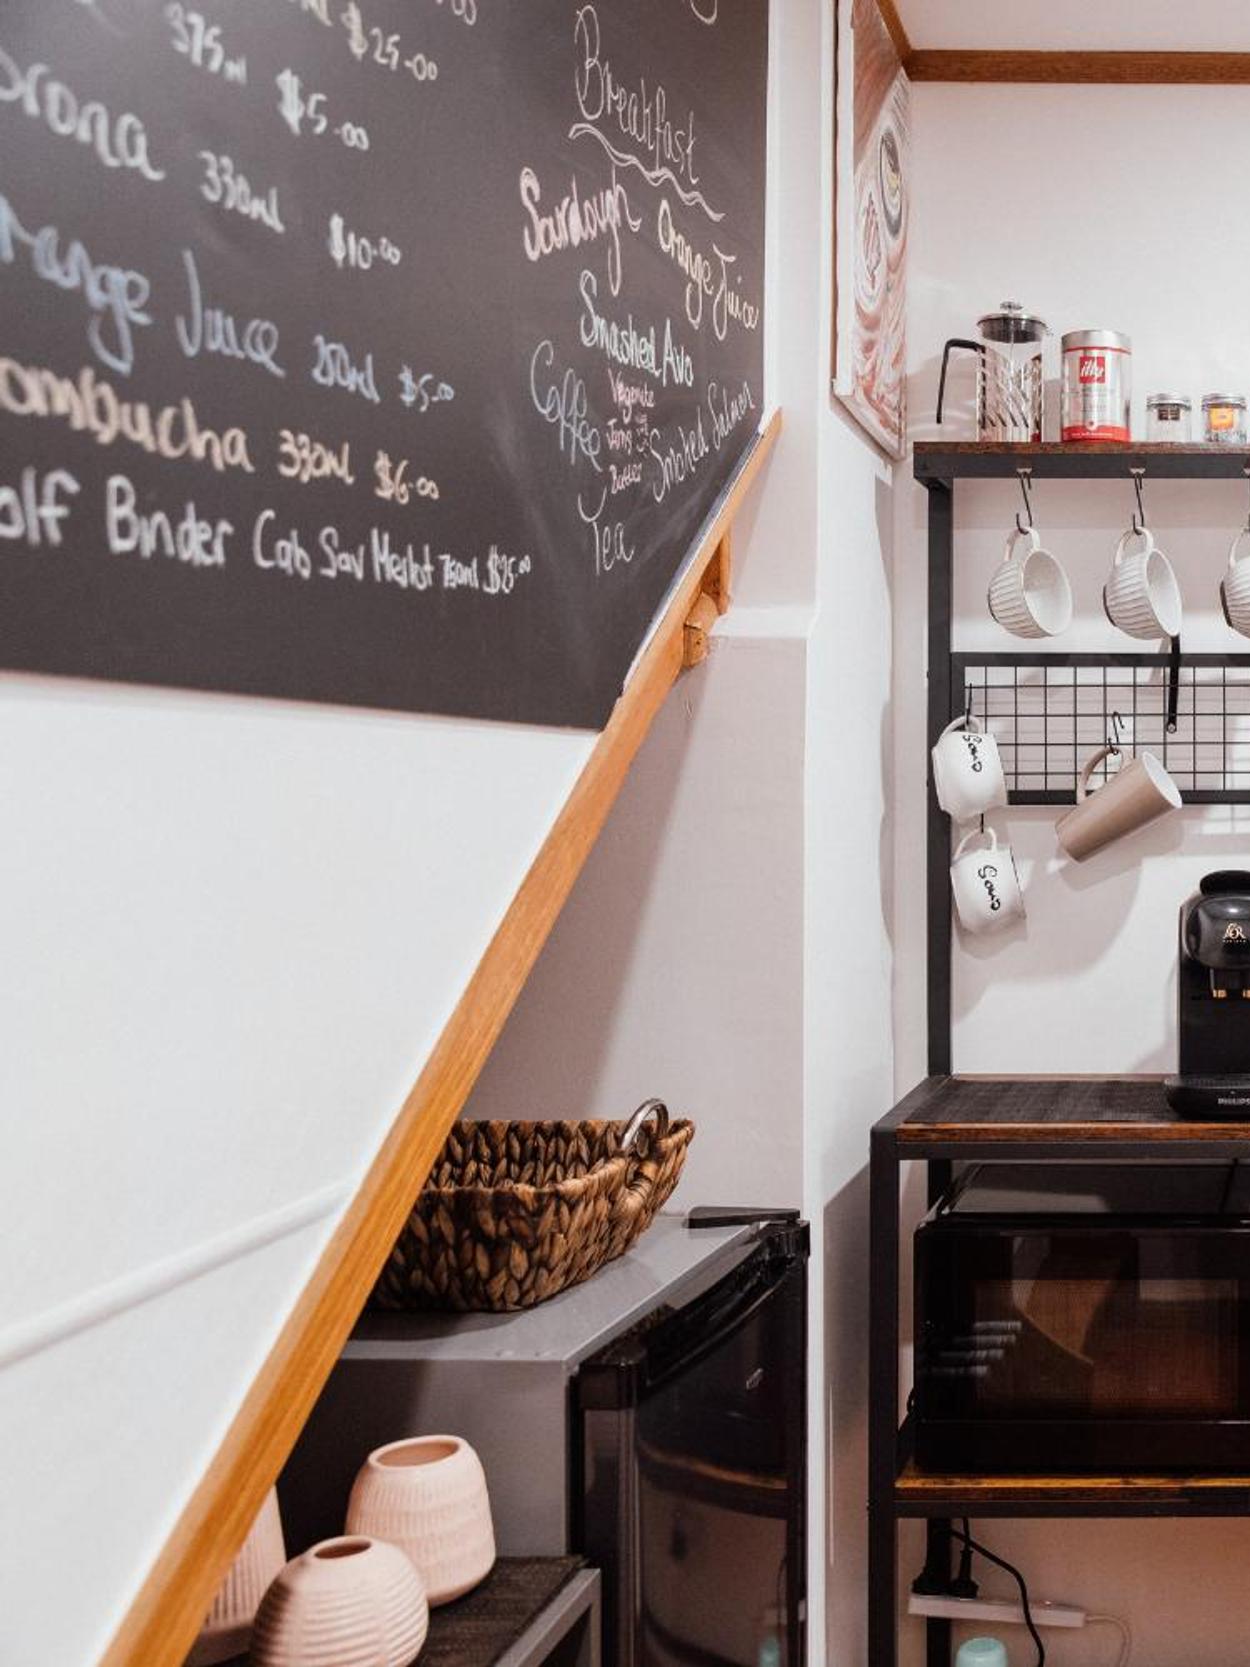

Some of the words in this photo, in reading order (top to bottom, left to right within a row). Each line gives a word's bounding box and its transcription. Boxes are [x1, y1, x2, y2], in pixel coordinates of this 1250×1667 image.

[574, 5, 700, 185] Breakfast
[519, 165, 643, 297] Sourdough
[658, 199, 714, 330] Orange
[712, 243, 759, 341] Juice
[579, 269, 662, 379] Smashed
[662, 317, 694, 388] Avo
[1080, 357, 1105, 379] illy
[530, 339, 603, 472] Coffee
[649, 428, 709, 503] Smoked
[707, 381, 756, 451] Salmon
[253, 508, 312, 580] Cab
[318, 526, 365, 581] Sav
[370, 527, 435, 590] Merlot
[577, 485, 638, 576] Tea
